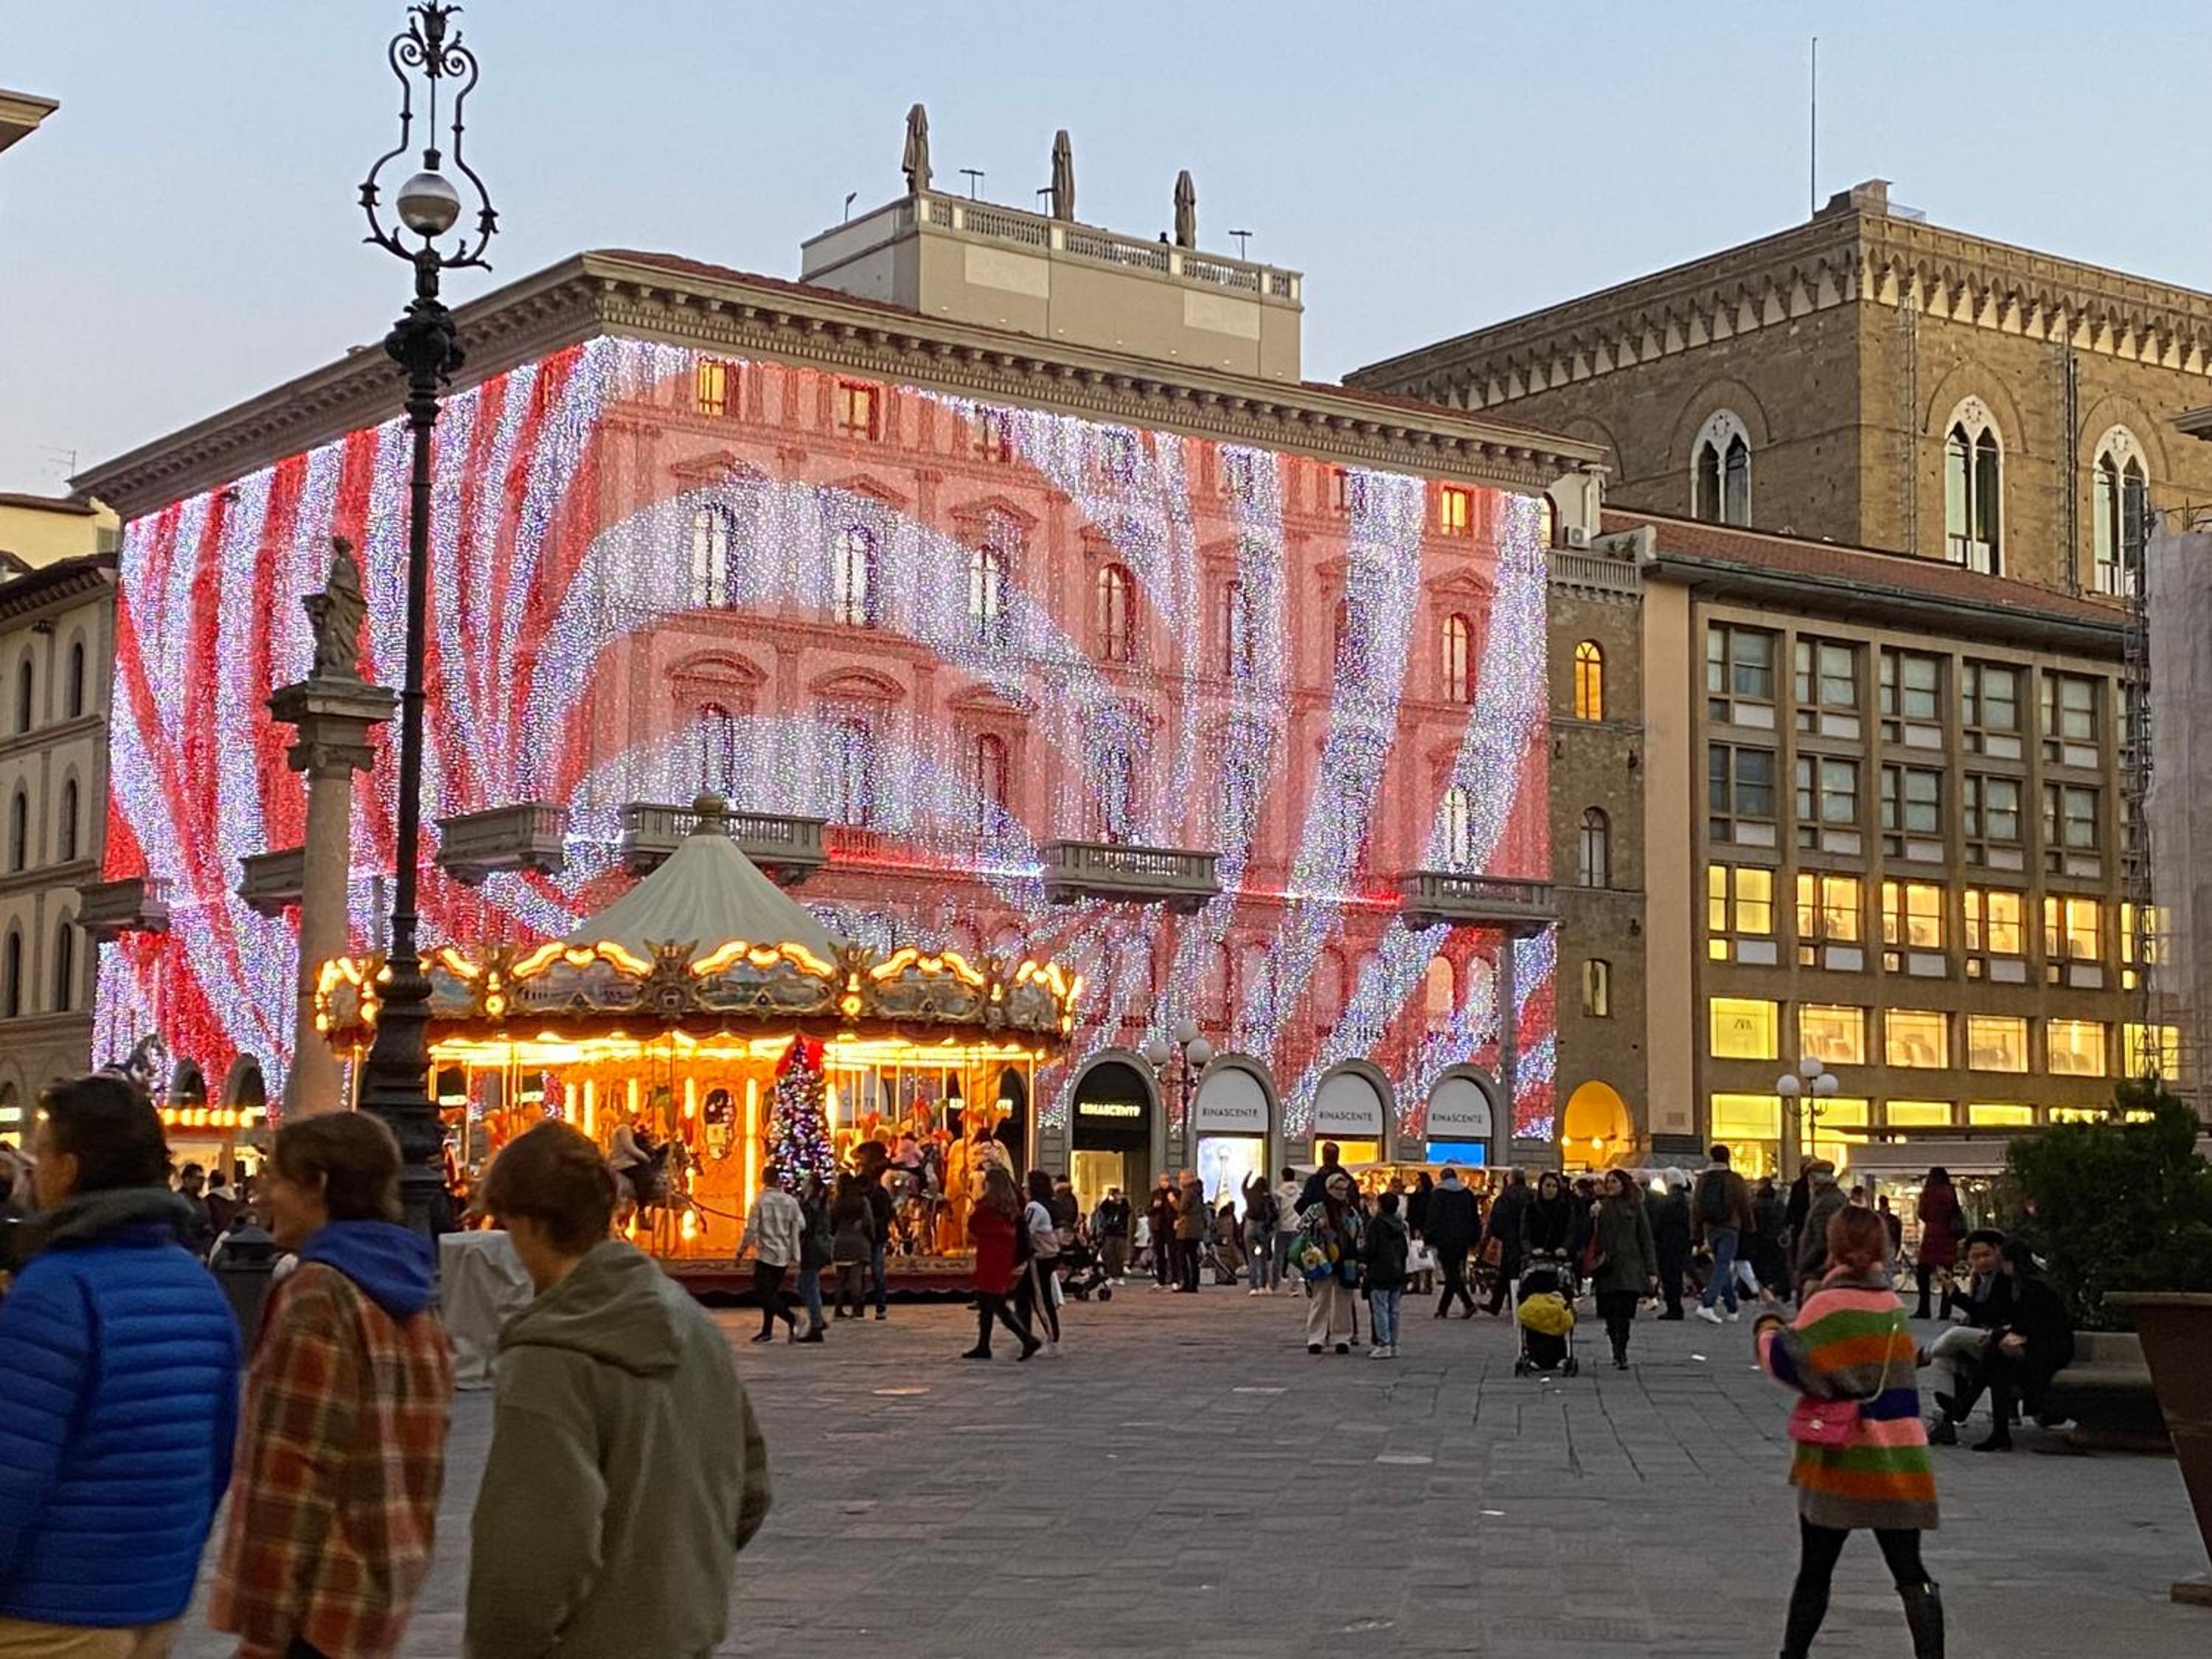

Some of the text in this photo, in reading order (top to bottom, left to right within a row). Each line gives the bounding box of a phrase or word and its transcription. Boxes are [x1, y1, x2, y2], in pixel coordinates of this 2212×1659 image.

[1203, 1107, 1257, 1118] RINASCENTE
[1319, 1110, 1374, 1121] RINASCENTE
[1432, 1113, 1483, 1124] RINASCENTE
